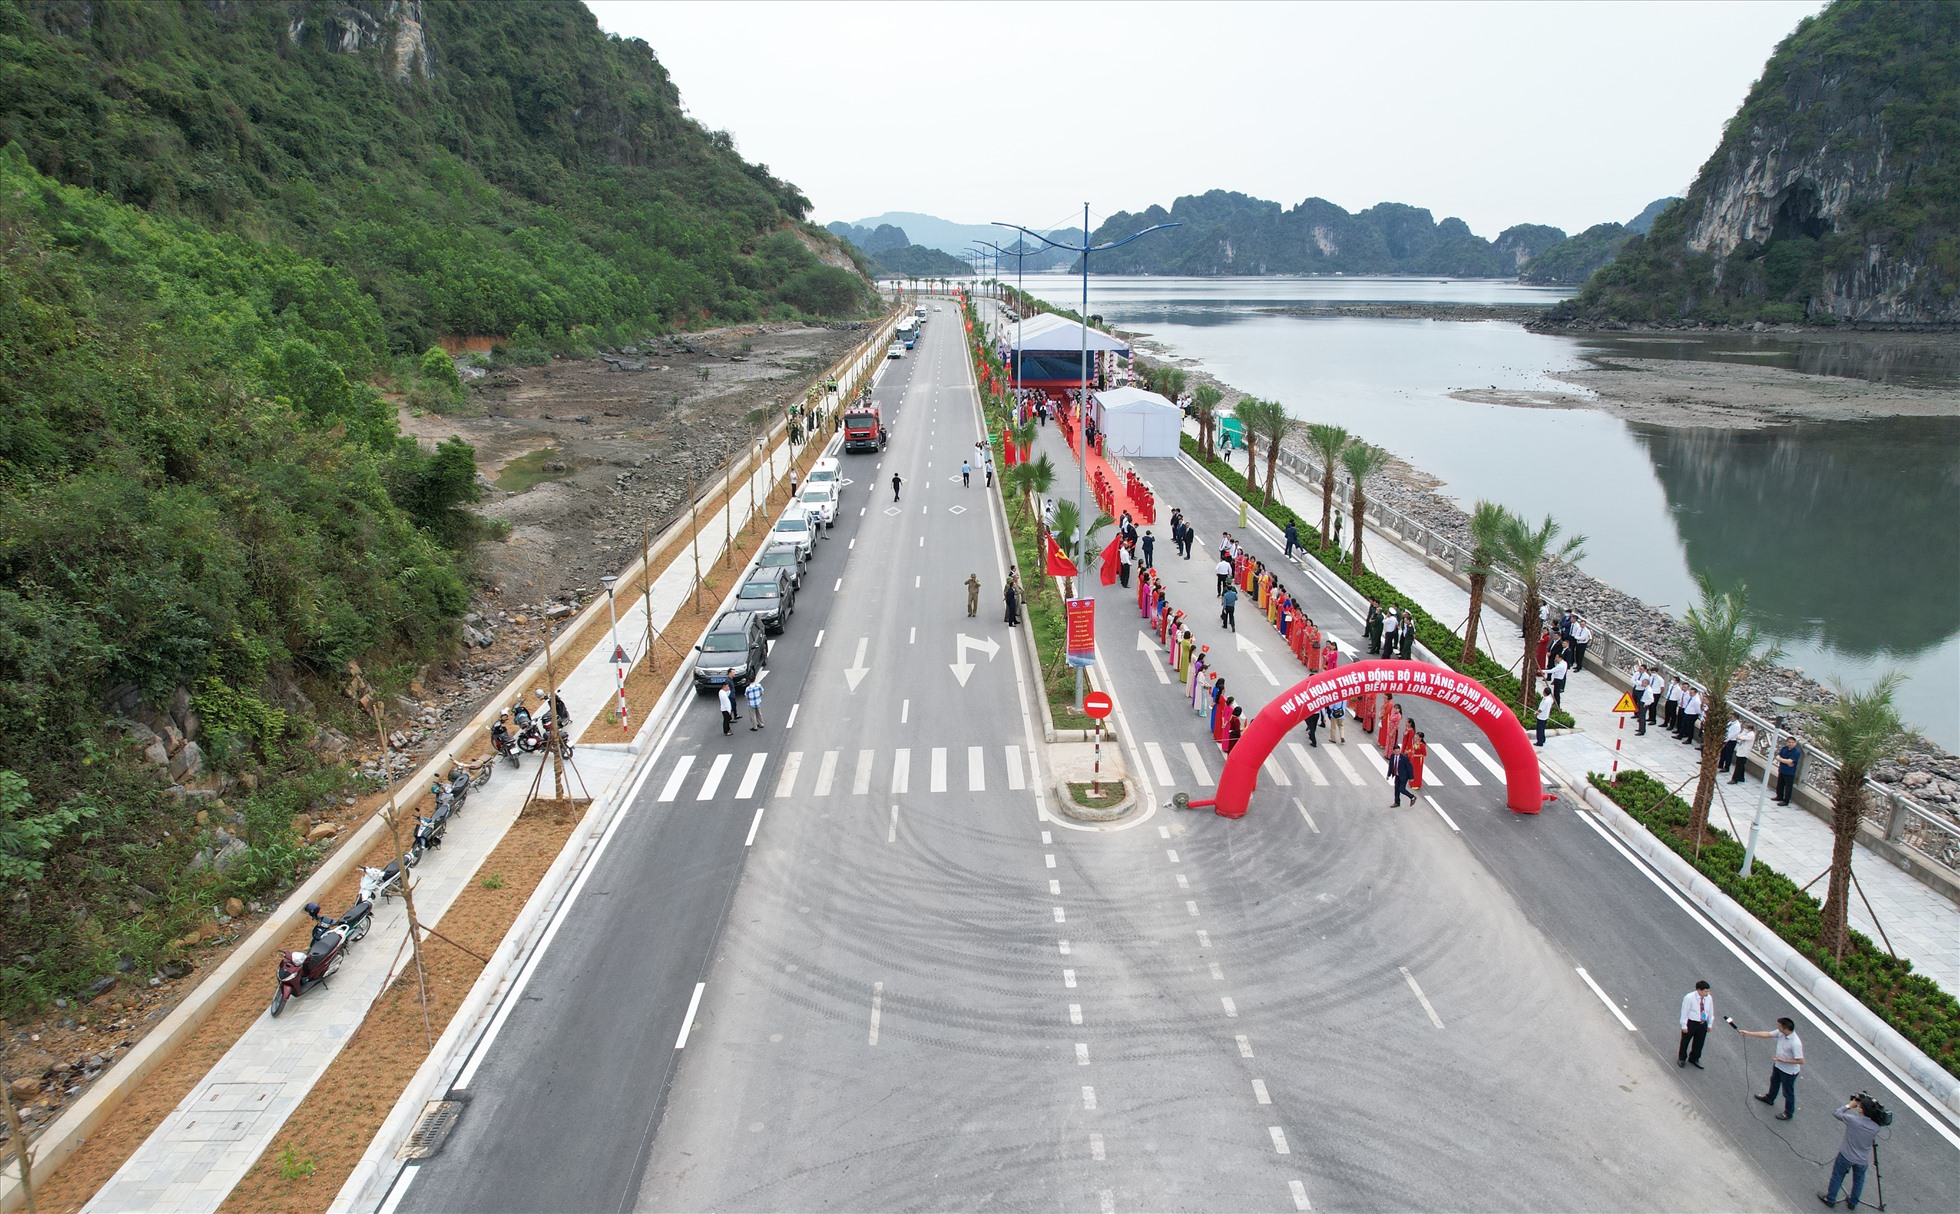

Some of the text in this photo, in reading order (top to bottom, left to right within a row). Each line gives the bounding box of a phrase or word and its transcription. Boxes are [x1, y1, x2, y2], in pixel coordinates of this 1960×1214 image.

[1281, 698, 1296, 715] DỰ
[1309, 679, 1337, 698] HOÀN
[1336, 671, 1366, 686] THIỆN
[1397, 669, 1410, 683] BỘ
[1413, 671, 1426, 684] HẠ
[1480, 697, 1503, 719] QUAN
[1307, 692, 1339, 712] ĐƯỜNG
[1341, 686, 1361, 698] BAO
[1389, 683, 1403, 693] HẠ
